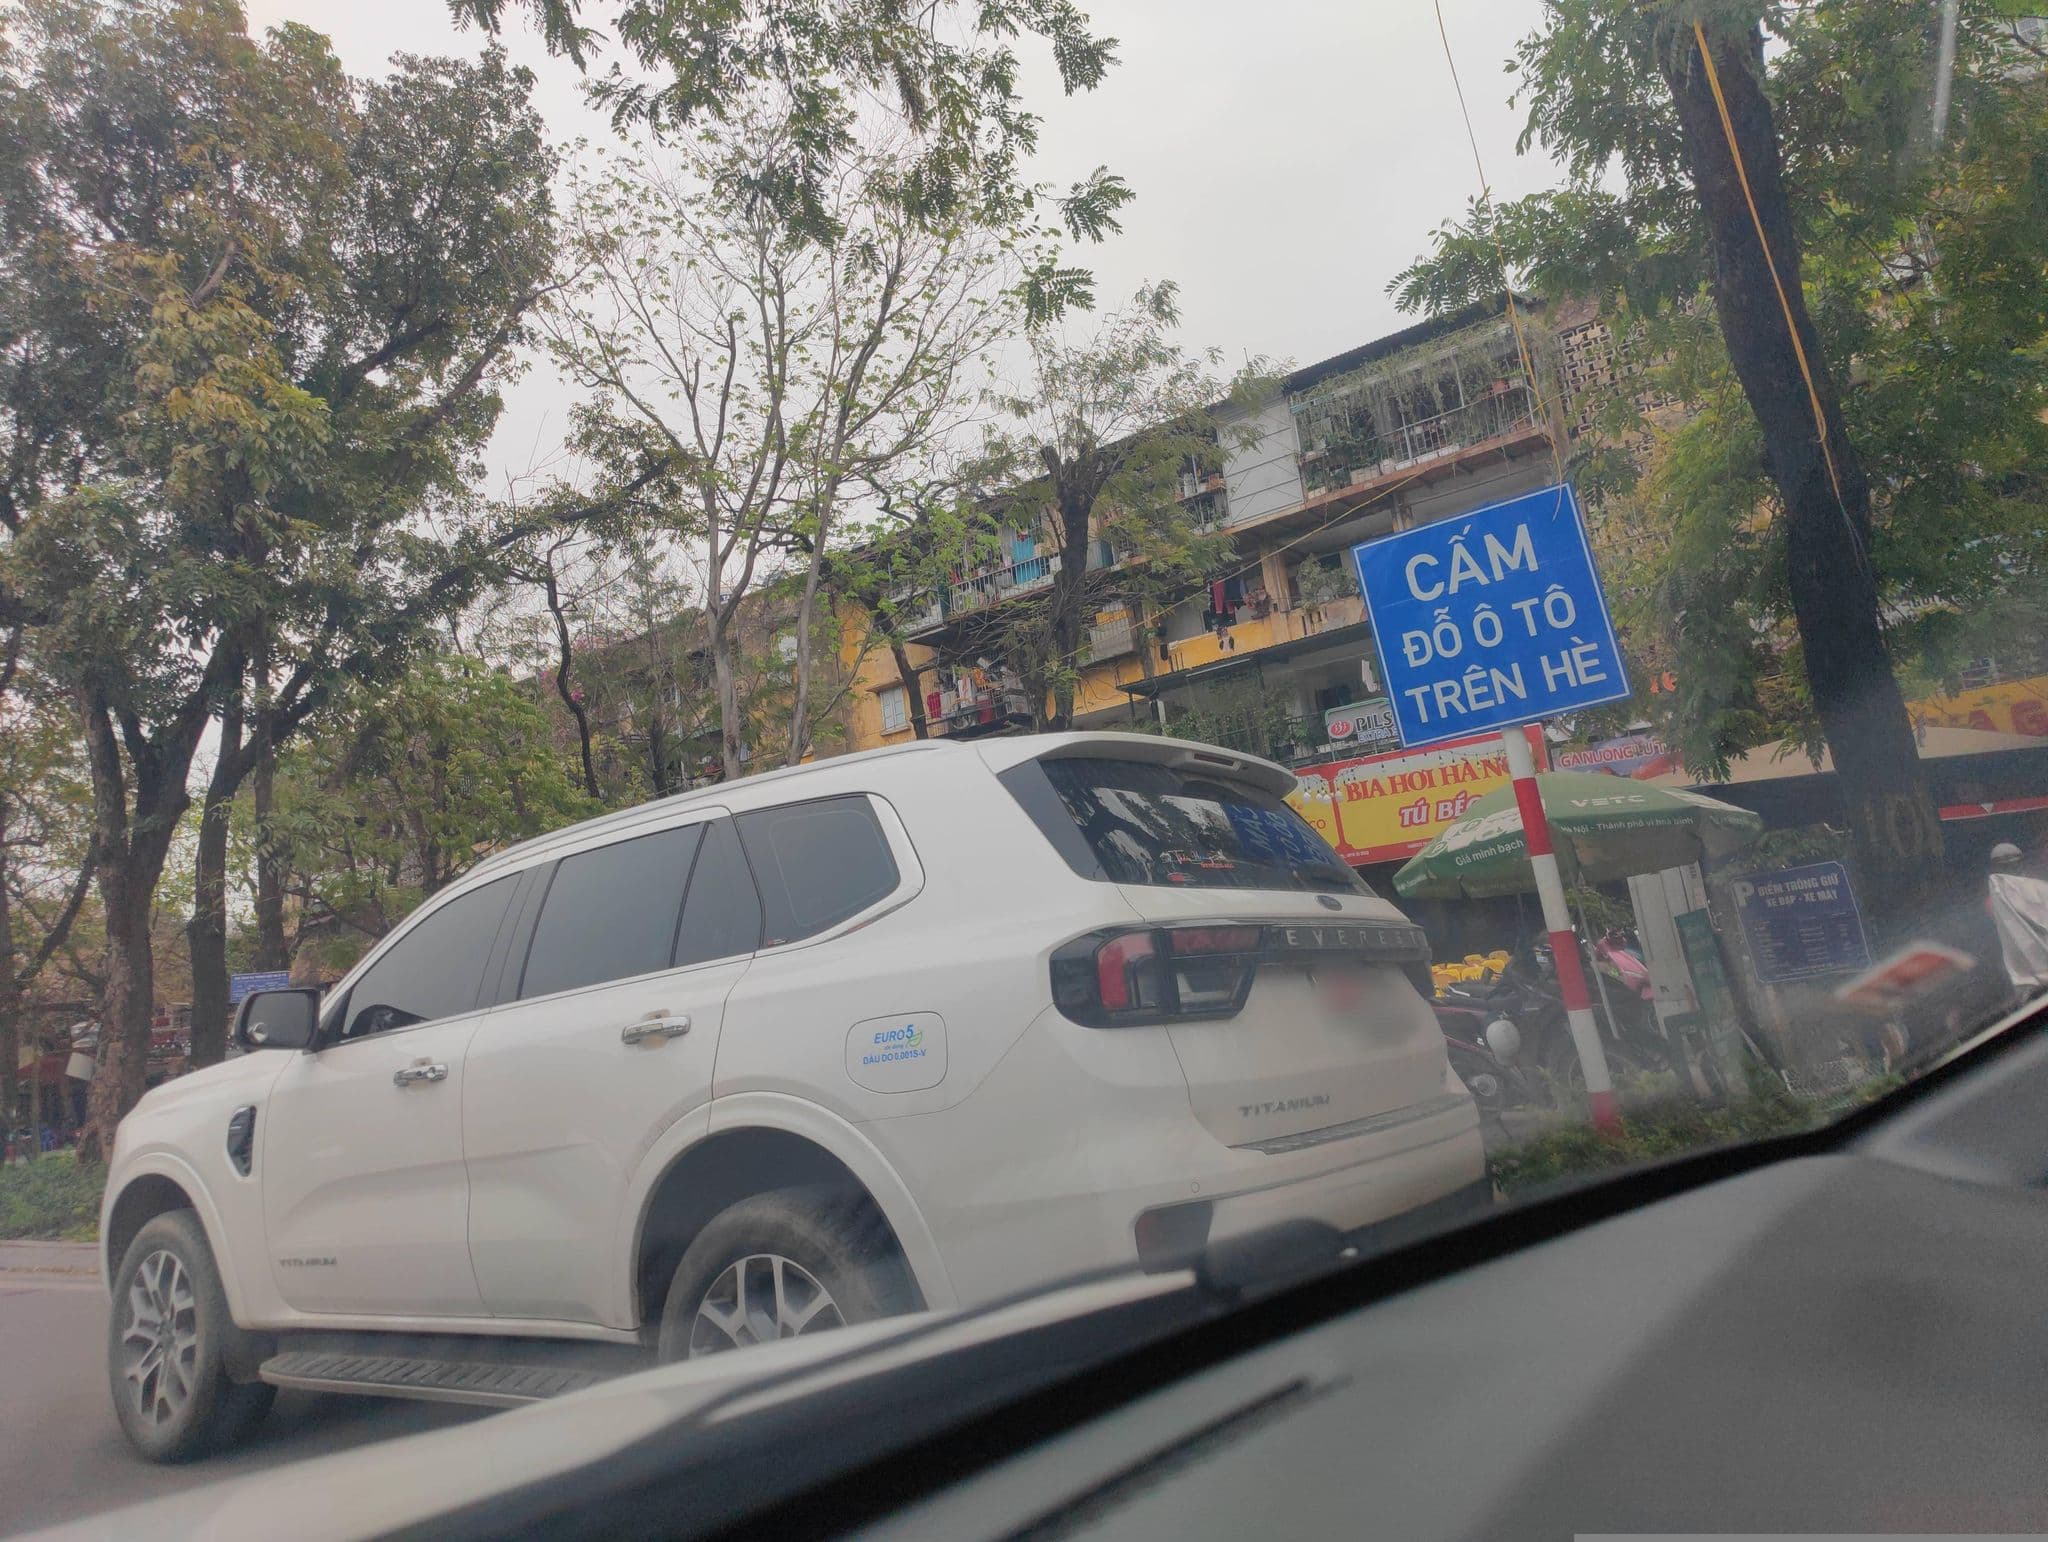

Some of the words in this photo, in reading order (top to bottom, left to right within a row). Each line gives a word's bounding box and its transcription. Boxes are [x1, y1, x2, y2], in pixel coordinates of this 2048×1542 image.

[1405, 523, 1539, 601] CẤM
[1402, 606, 1462, 667] ĐỖ
[1472, 602, 1503, 648] Ô
[1511, 583, 1576, 637] TÔ
[1404, 663, 1527, 723] TRÊN
[1540, 636, 1607, 692] HÈ
[1345, 779, 1386, 802] BIA
[1439, 757, 1479, 786] HÀ
[1400, 798, 1430, 827] TÚ
[1570, 795, 1645, 808] VETC
[1455, 854, 1472, 866] Giá
[1472, 847, 1497, 861] minh
[1497, 839, 1525, 854] bạch
[1286, 929, 1420, 946] EVEREST
[1239, 1095, 1330, 1117] TITANIUM
